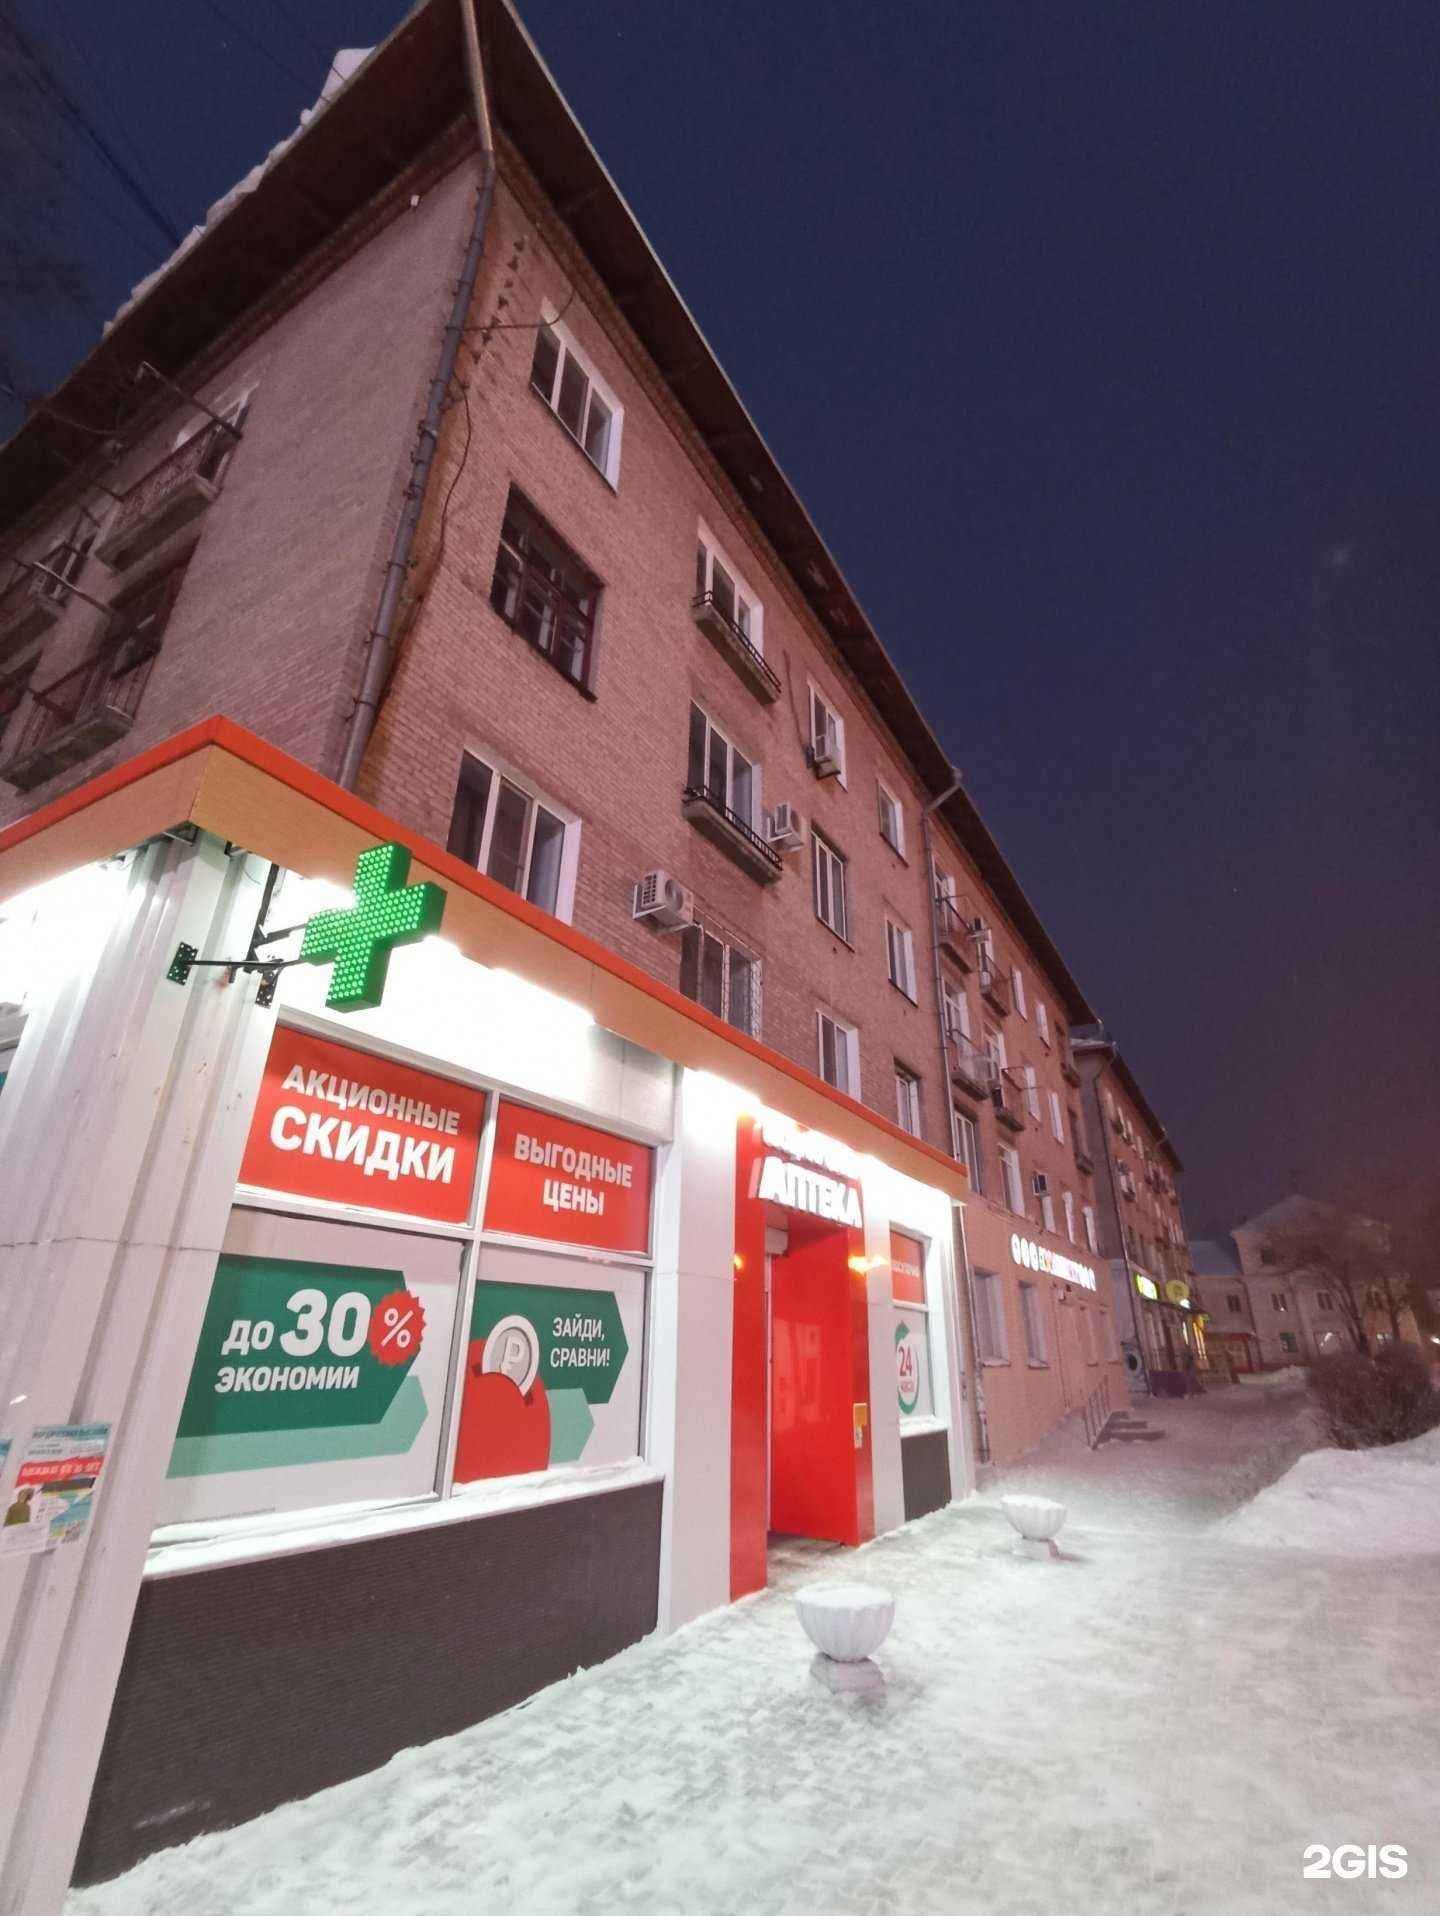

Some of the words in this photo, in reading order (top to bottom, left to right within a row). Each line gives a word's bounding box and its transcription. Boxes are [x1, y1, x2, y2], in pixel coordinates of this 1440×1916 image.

[281, 1064, 460, 1136] АКЦИОННЫЕ
[270, 1105, 456, 1184] СКИДКИ
[514, 1134, 633, 1189] ВЫГОДНЫЕ
[542, 1178, 605, 1216] ЦЕНЫ
[759, 1155, 863, 1228] АПТЕКА
[279, 1288, 372, 1357] 30
[552, 1313, 606, 1342] ЗАЙДИ,
[214, 1365, 360, 1393] ЭКОНОМИИ
[550, 1347, 611, 1368] СРАВНИ!
[898, 1346, 913, 1377] 24
